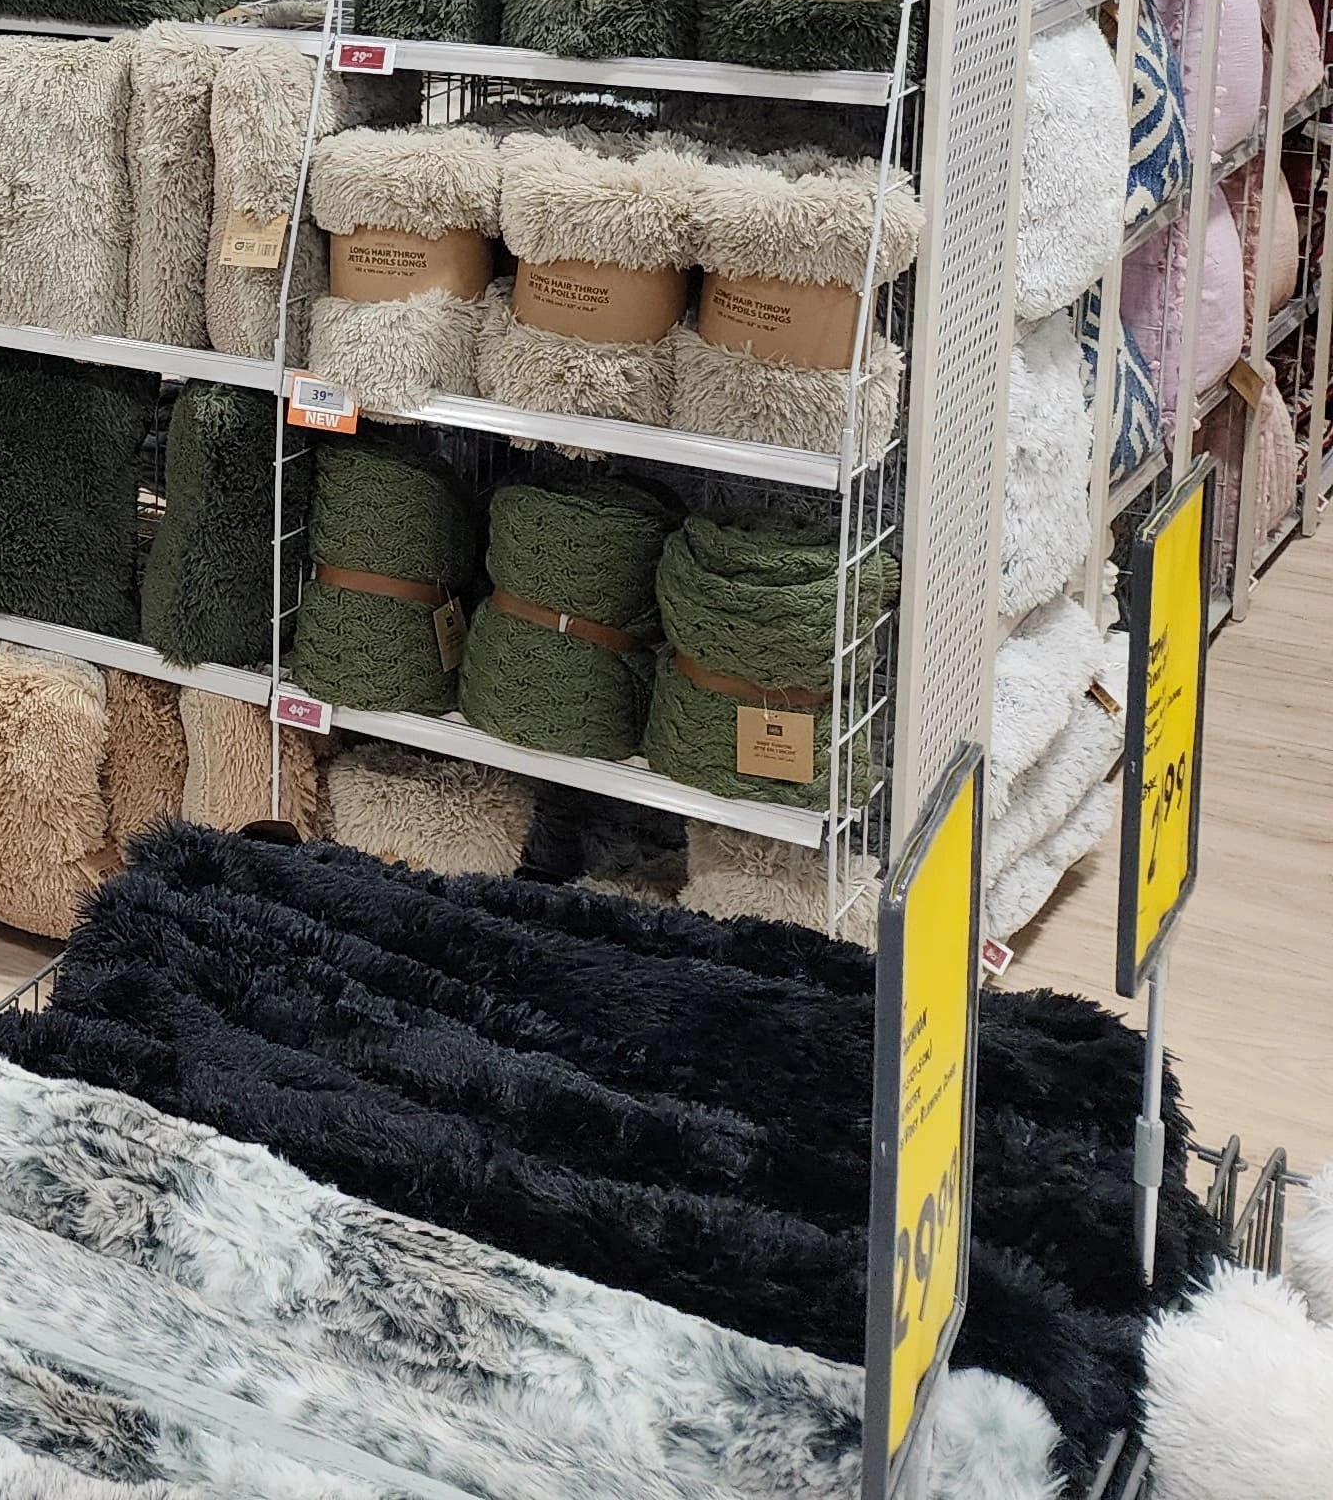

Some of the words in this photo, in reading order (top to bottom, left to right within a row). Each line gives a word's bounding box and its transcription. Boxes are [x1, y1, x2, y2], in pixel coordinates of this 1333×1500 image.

[349, 246, 371, 255] LONG
[371, 248, 392, 258] HAIR
[393, 250, 426, 260] THROW
[371, 256, 396, 267] POILS
[396, 259, 427, 269] LONGS
[530, 271, 550, 285] LONG
[551, 279, 572, 291] HAIR
[574, 283, 609, 296] THROW
[551, 288, 577, 301] POILS
[577, 293, 610, 305] LONGS
[732, 295, 753, 308] HAIR
[754, 300, 791, 315] THROW
[732, 304, 757, 318] POILS
[757, 311, 792, 325] LONGS
[304, 410, 341, 429] NEW
[893, 1146, 958, 1349] 2999
